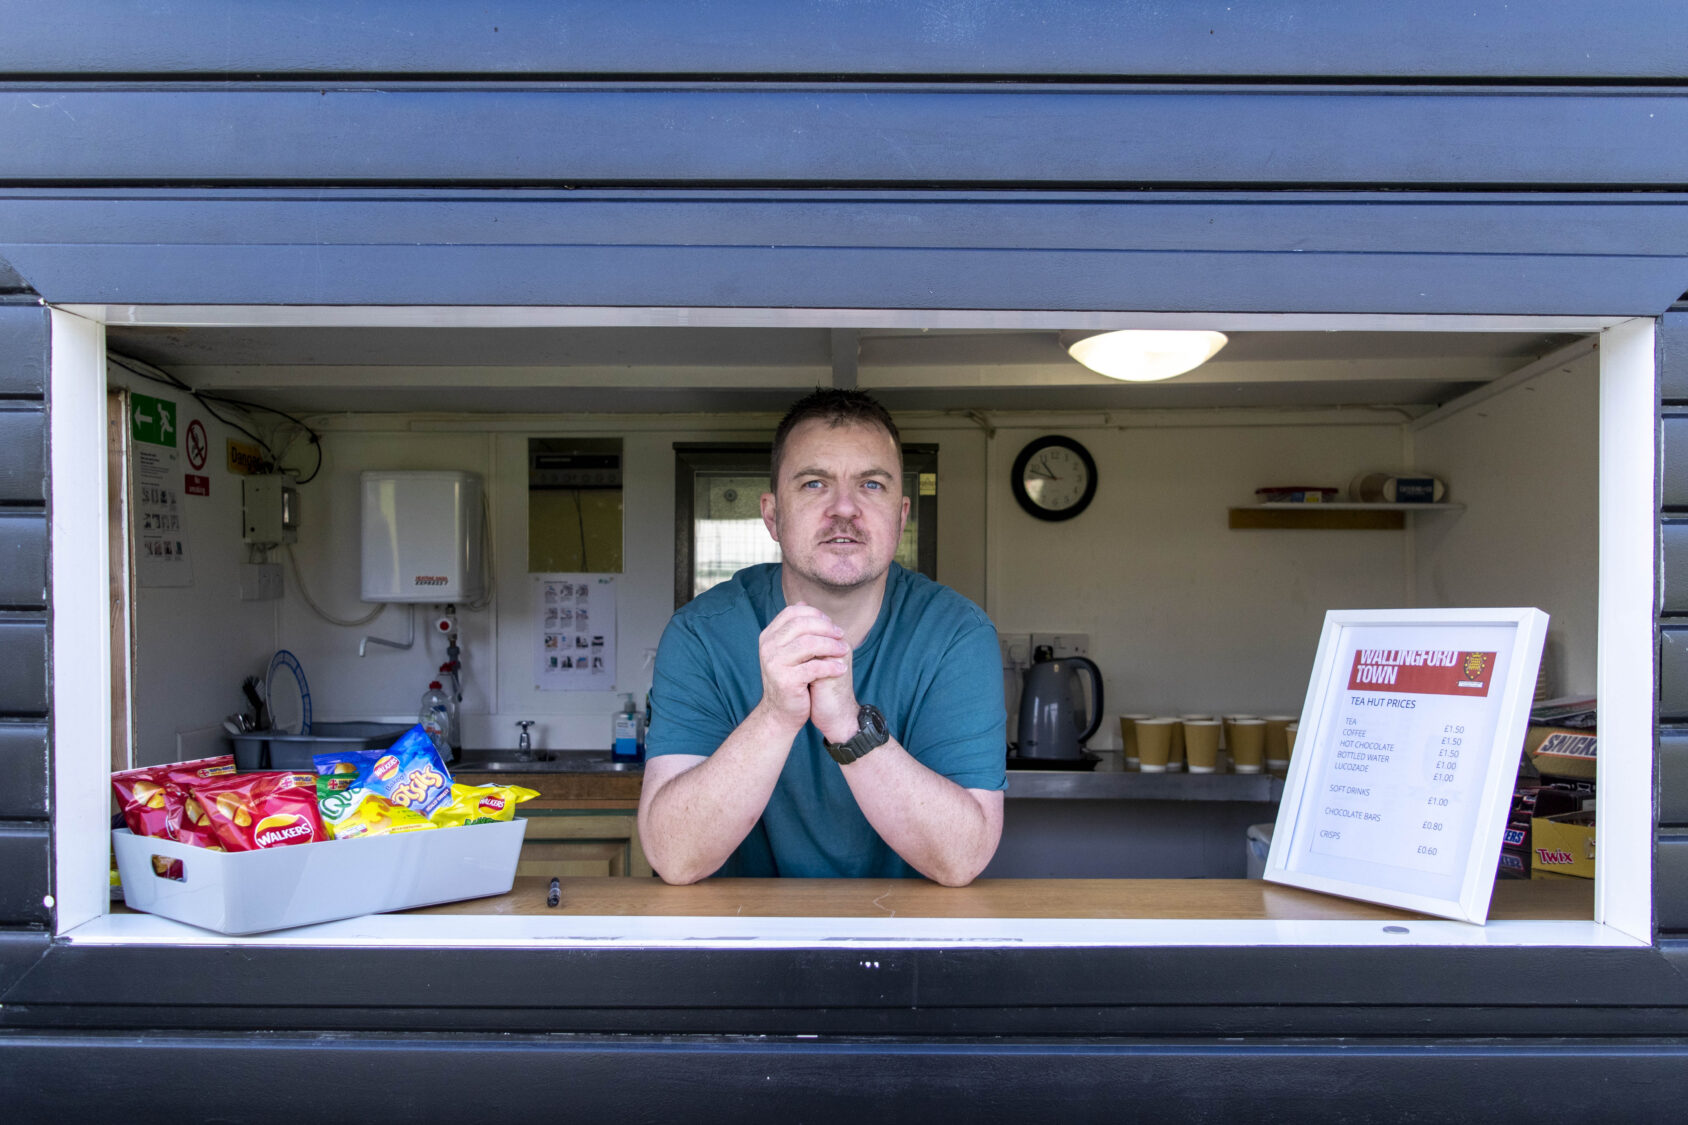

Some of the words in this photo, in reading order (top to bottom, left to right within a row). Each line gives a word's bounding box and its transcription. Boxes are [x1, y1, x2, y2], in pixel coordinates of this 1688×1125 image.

[1360, 650, 1458, 666] WALLINGFORD
[1356, 665, 1398, 684] TOWN
[1351, 696, 1365, 705] TEA
[1368, 698, 1384, 707] HUT
[1387, 699, 1416, 709] PRICES
[1343, 729, 1366, 737] COFFEE
[1444, 725, 1464, 734] £1.50
[1340, 740, 1353, 748] HOT
[1355, 741, 1395, 752] CHOCOLATE
[1441, 737, 1462, 746] £1.50
[1337, 751, 1366, 761] BOTTLED
[1367, 754, 1390, 763] WATER
[1439, 749, 1459, 758] £1.50
[374, 757, 399, 778] WALKERS
[1335, 762, 1369, 773] LUCOZADE
[1436, 761, 1456, 770] £1.00
[386, 775, 405, 791] Baked
[1433, 773, 1454, 782] £1.00
[391, 764, 445, 808] otsits
[1329, 784, 1346, 793] SOFT
[1347, 786, 1371, 796] DRINKS
[480, 797, 505, 809] WALKERS
[1427, 797, 1448, 806] £1.00
[1325, 807, 1363, 819] CHOCOLATE
[1363, 812, 1381, 822] BARS
[1422, 821, 1443, 831] £0.80
[258, 823, 311, 846] WALKERS
[1320, 830, 1341, 840] CRISPS
[1504, 830, 1523, 844] ERS
[1417, 845, 1437, 856] £0.60
[1536, 848, 1574, 864] Twix
